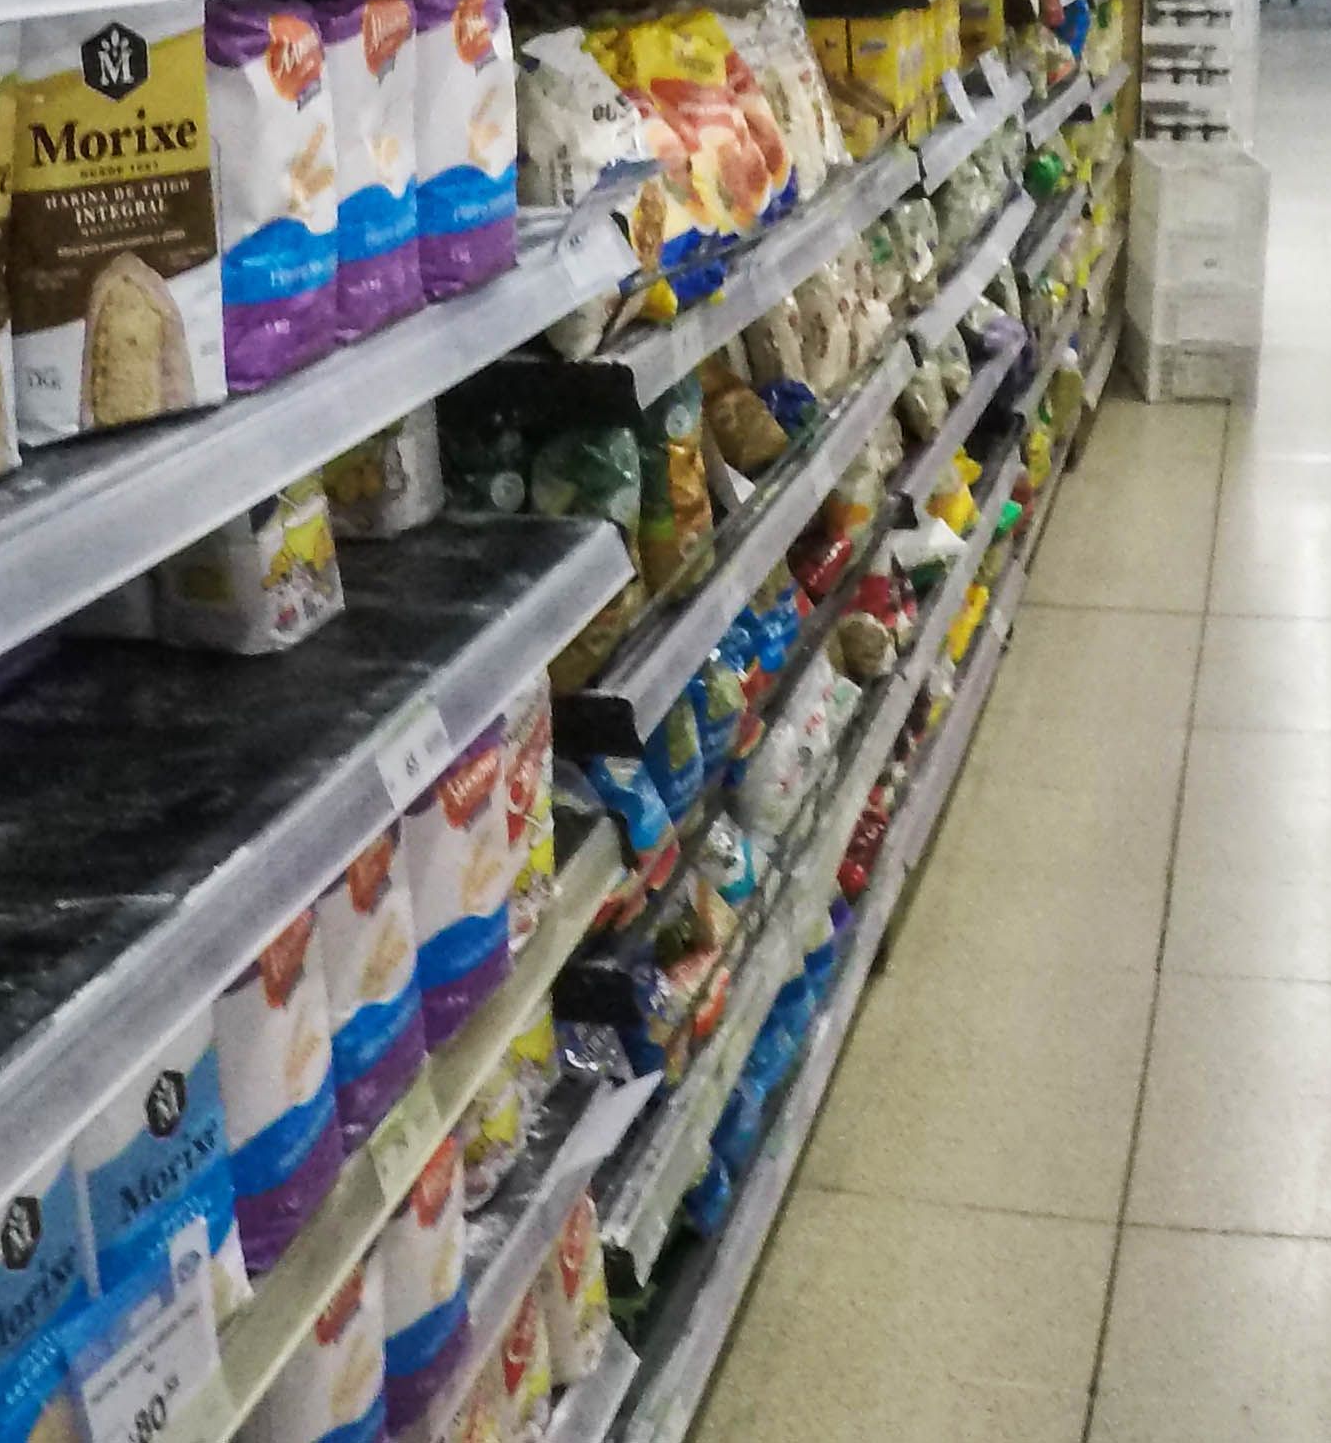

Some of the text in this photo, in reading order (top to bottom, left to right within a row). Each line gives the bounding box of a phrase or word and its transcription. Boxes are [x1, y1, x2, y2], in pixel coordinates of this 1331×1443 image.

[28, 106, 198, 167] Morixe
[45, 189, 109, 210] HARINA
[113, 185, 135, 202] DE
[74, 197, 165, 226] INTEGRAL
